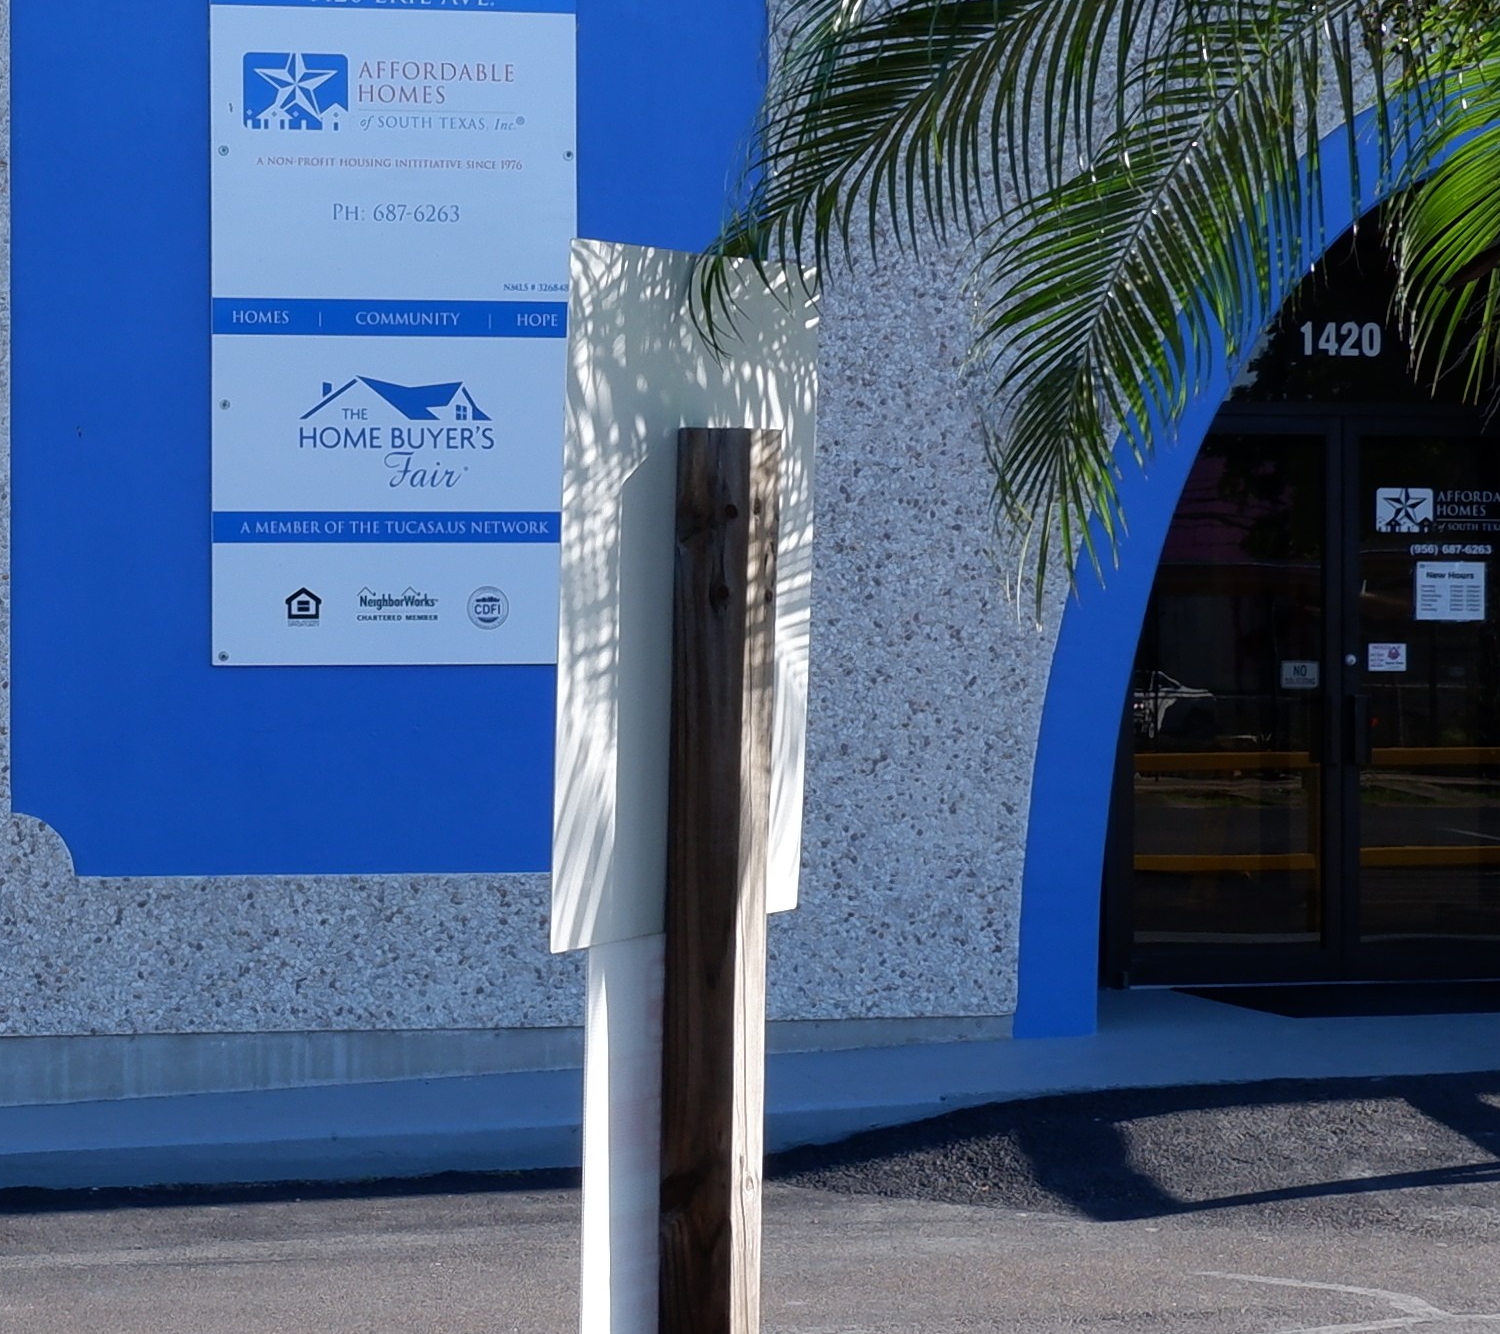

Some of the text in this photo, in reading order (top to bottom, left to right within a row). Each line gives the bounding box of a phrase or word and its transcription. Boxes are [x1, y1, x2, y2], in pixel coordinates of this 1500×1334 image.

[359, 60, 515, 83] AFFORDABLE
[358, 84, 447, 105] HOMES
[359, 116, 374, 131] of
[378, 116, 432, 130] SOUTH
[256, 156, 264, 166] A
[267, 156, 336, 167] NON-PROFIT
[339, 158, 392, 168] HOUSING
[465, 159, 497, 170] SINCE
[500, 160, 523, 171] 1976
[372, 203, 460, 223] 687-6263
[232, 310, 558, 327] HOMES COMMUNITY HOPE
[1300, 320, 1382, 358] 1420
[341, 407, 368, 420] THE
[299, 425, 495, 450] HOME BUYER'S
[383, 451, 462, 488] Fair
[1436, 504, 1487, 517] HOMES
[240, 521, 549, 535] A MEMBER OF THE TUCASA.US NETWORK
[1448, 522, 1479, 531] SOUTH
[1410, 544, 1492, 556] (956) 687-6263
[359, 593, 436, 611] NeighborWorks
[474, 603, 501, 616] CDFI
[1293, 665, 1307, 677] NO
